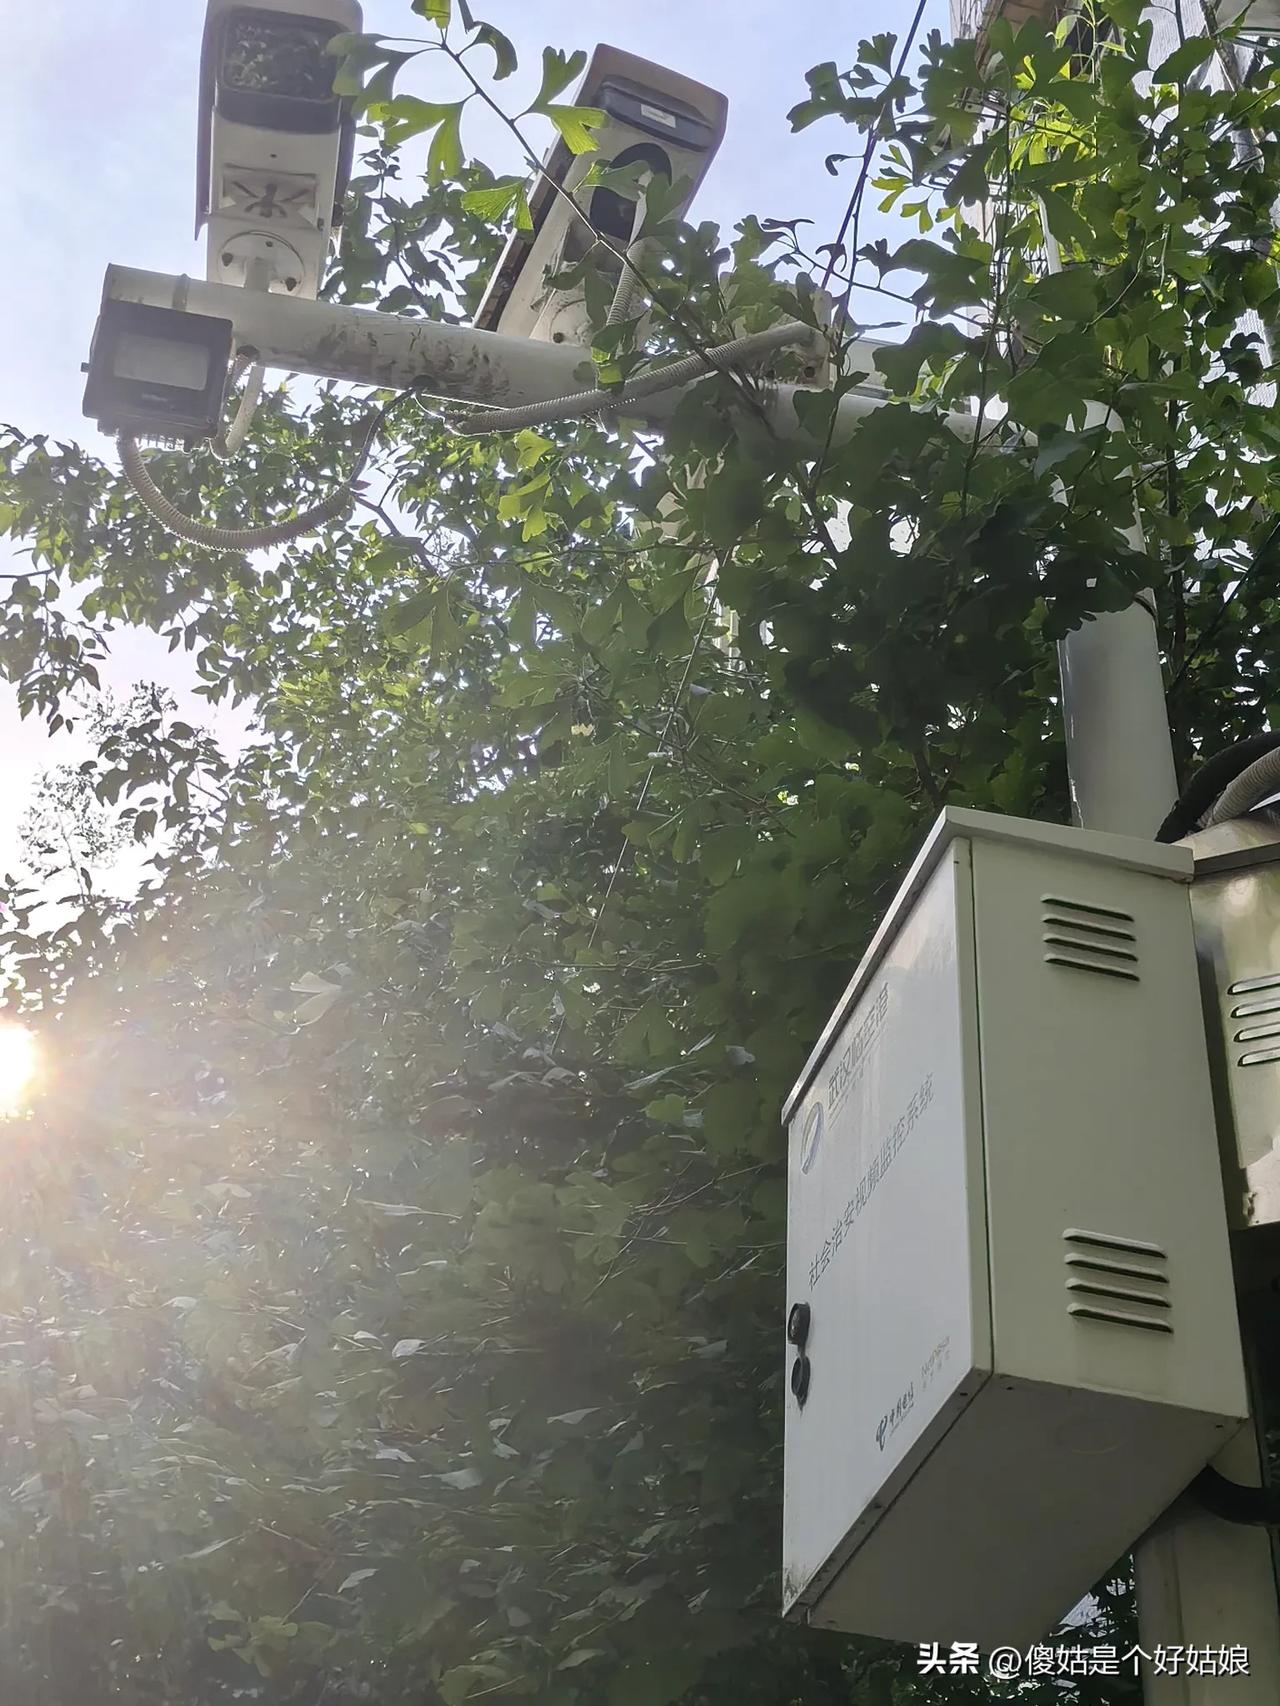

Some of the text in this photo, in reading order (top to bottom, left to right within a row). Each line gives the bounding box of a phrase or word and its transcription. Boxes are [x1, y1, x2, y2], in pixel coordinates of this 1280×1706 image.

[808, 1071, 934, 1291] 社会治安视频监控系统
